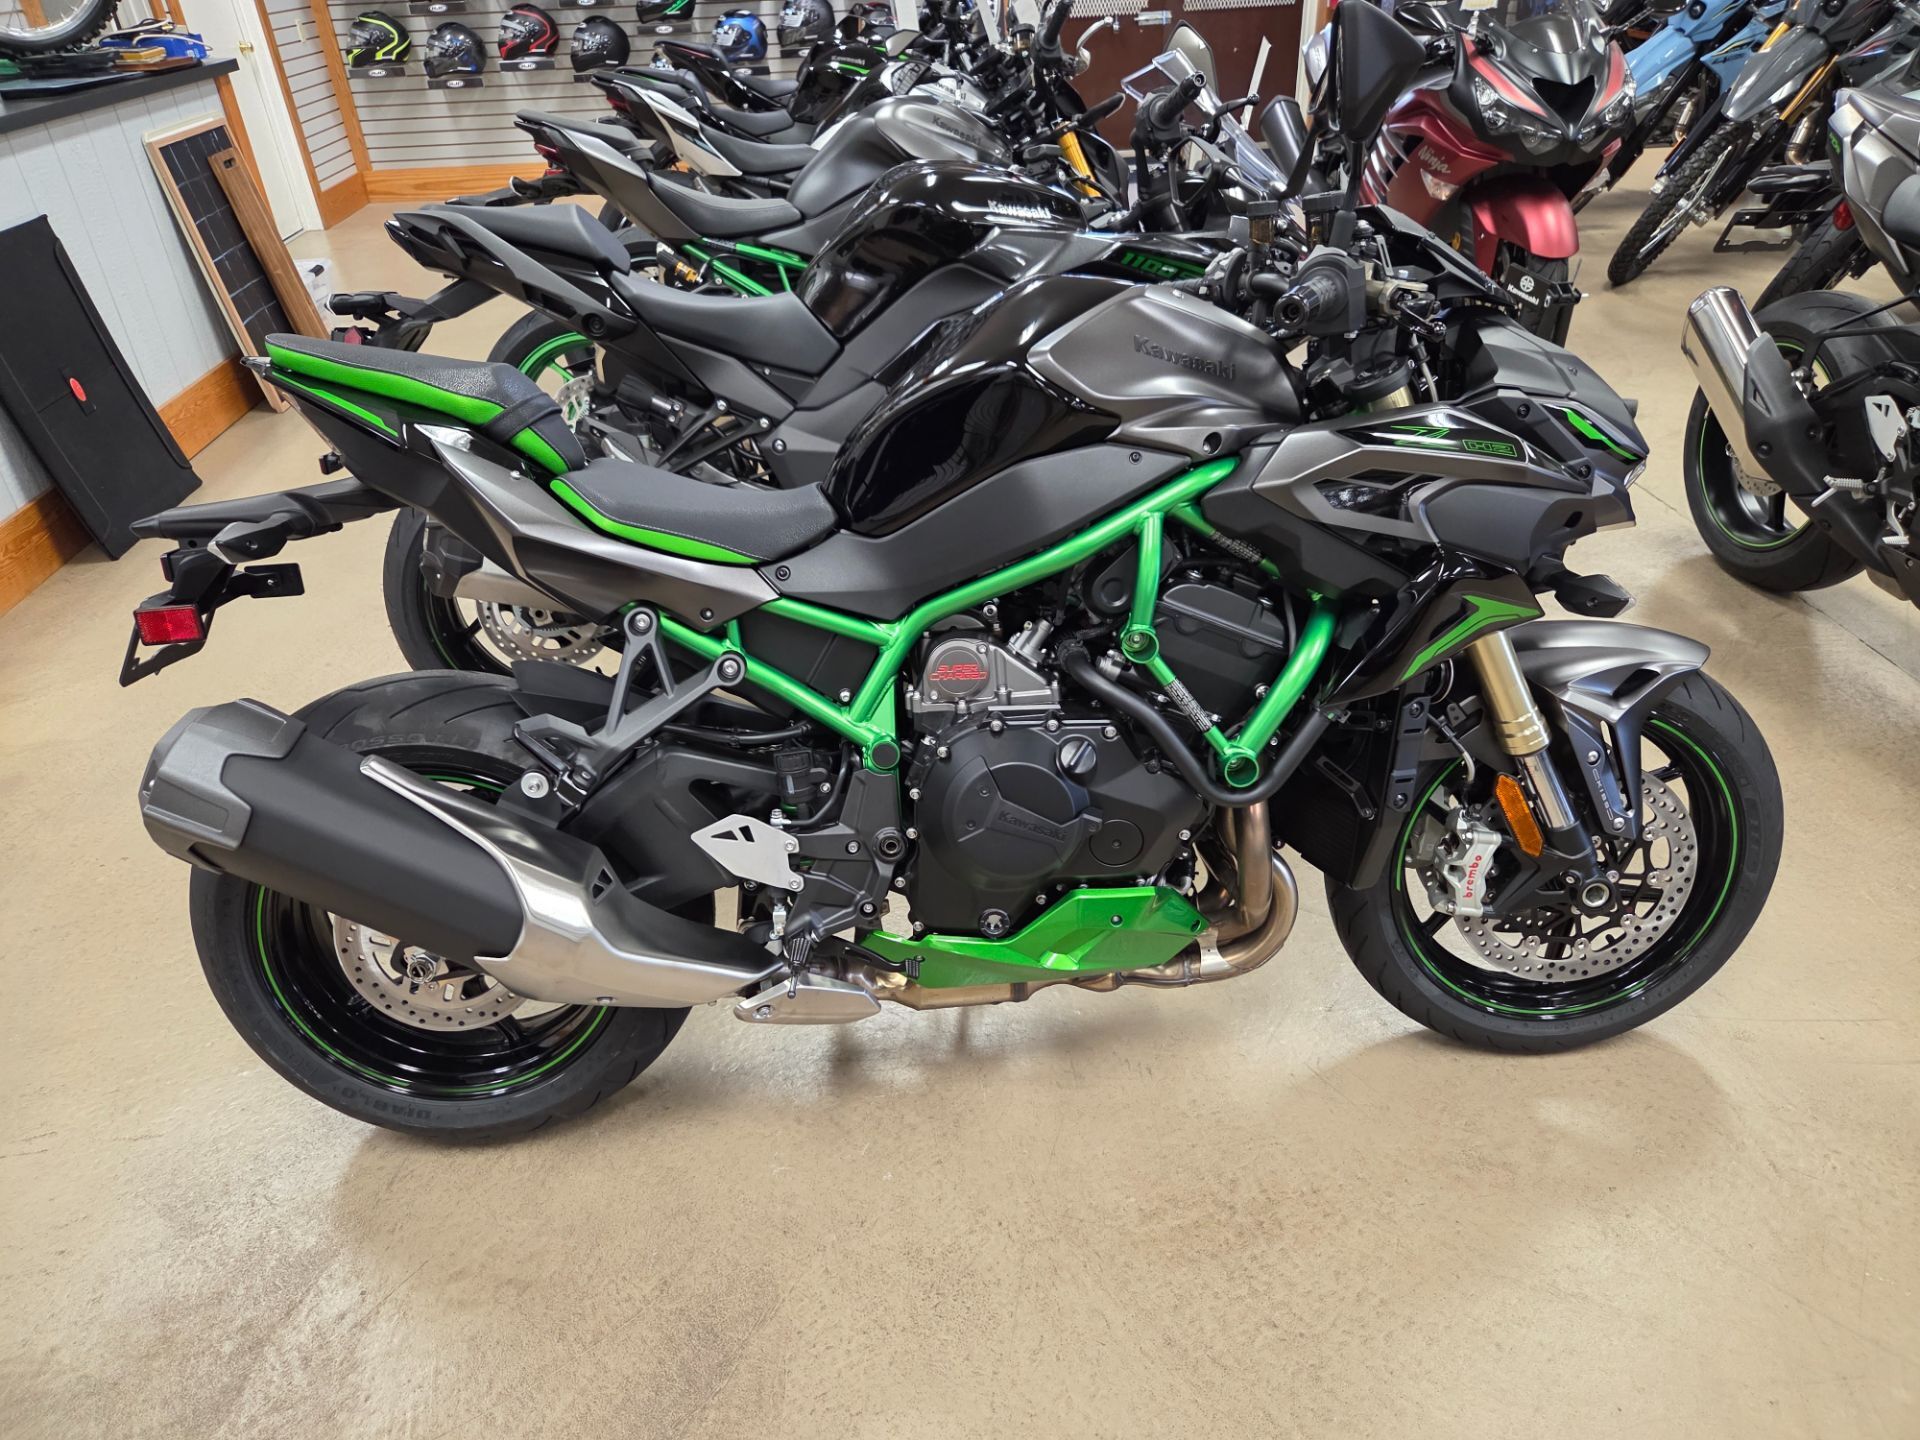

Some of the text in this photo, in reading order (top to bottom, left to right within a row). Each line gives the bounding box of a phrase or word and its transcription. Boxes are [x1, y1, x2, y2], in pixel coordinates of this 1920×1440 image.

[831, 55, 865, 66] Kawasaki
[932, 115, 982, 145] Kawasaki
[1418, 145, 1451, 174] Ninja
[988, 200, 1051, 219] Kawasaki
[1507, 283, 1540, 306] Kawasaki
[1133, 334, 1236, 380] Kawasaki
[1464, 440, 1515, 456] H2
[929, 671, 988, 681] CHARGED
[937, 664, 979, 673] SUPER
[998, 810, 1067, 842] Kawasaki
[1463, 855, 1482, 899] brembo
